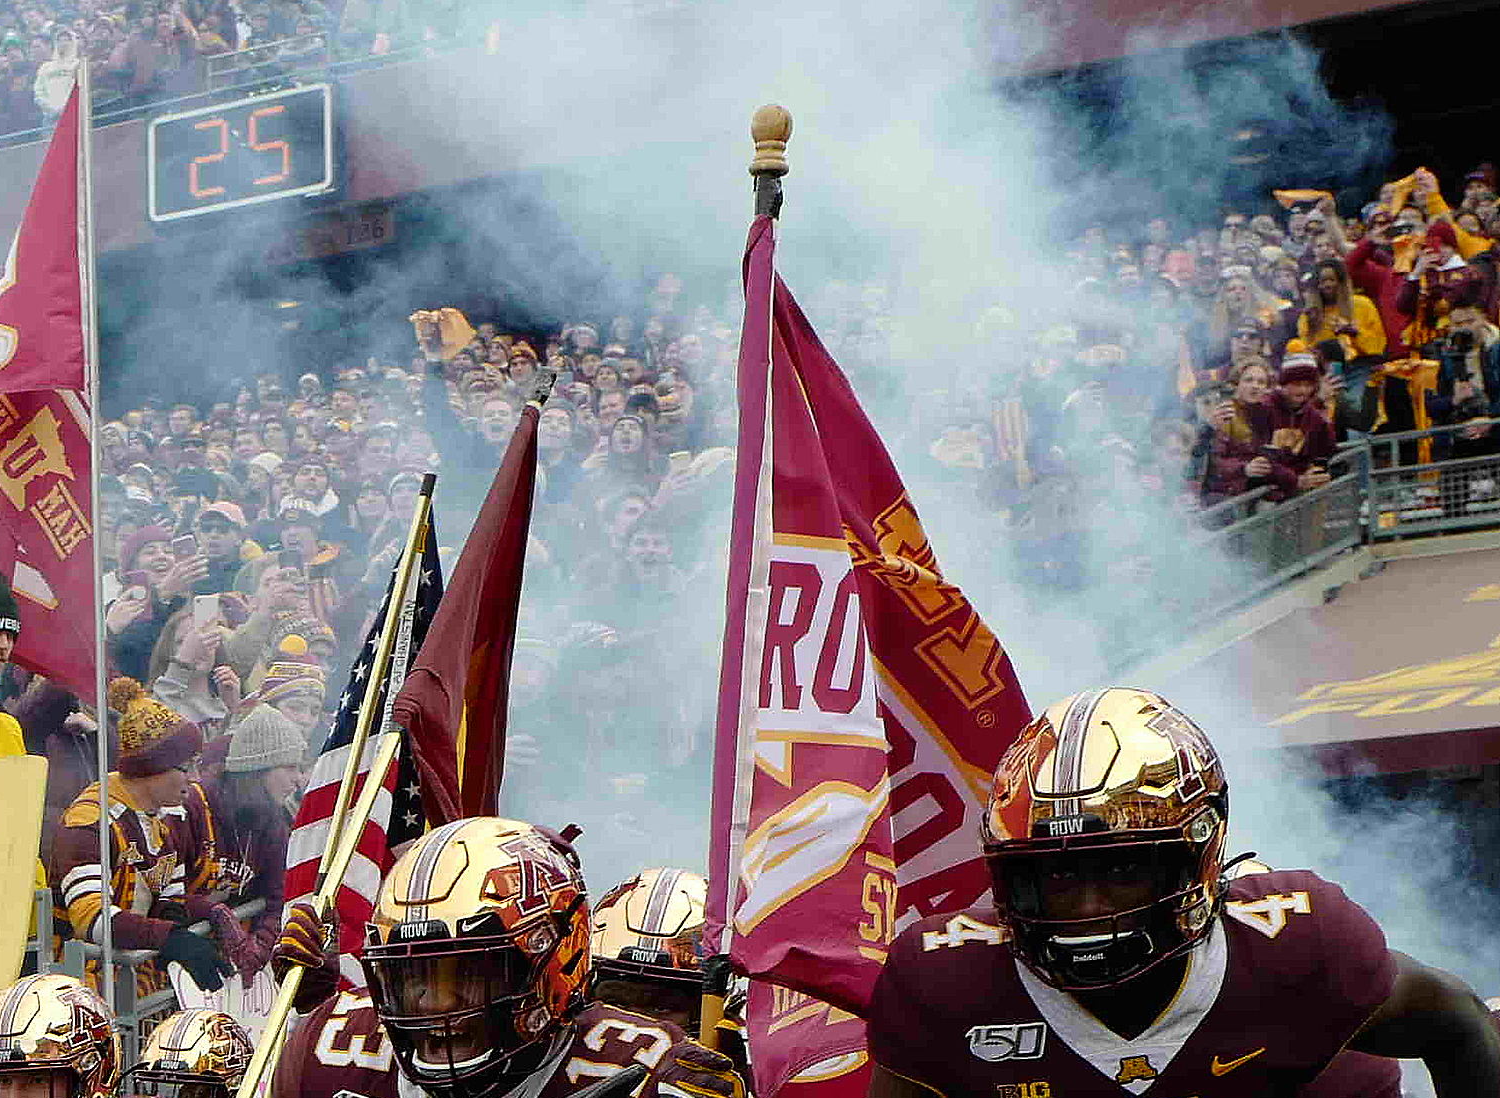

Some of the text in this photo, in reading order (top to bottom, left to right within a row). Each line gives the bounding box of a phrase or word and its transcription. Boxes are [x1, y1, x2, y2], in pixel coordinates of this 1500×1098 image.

[1049, 817, 1084, 836] ROW
[1225, 890, 1312, 940] 4
[399, 921, 429, 939] ROW
[922, 913, 1012, 952] 4
